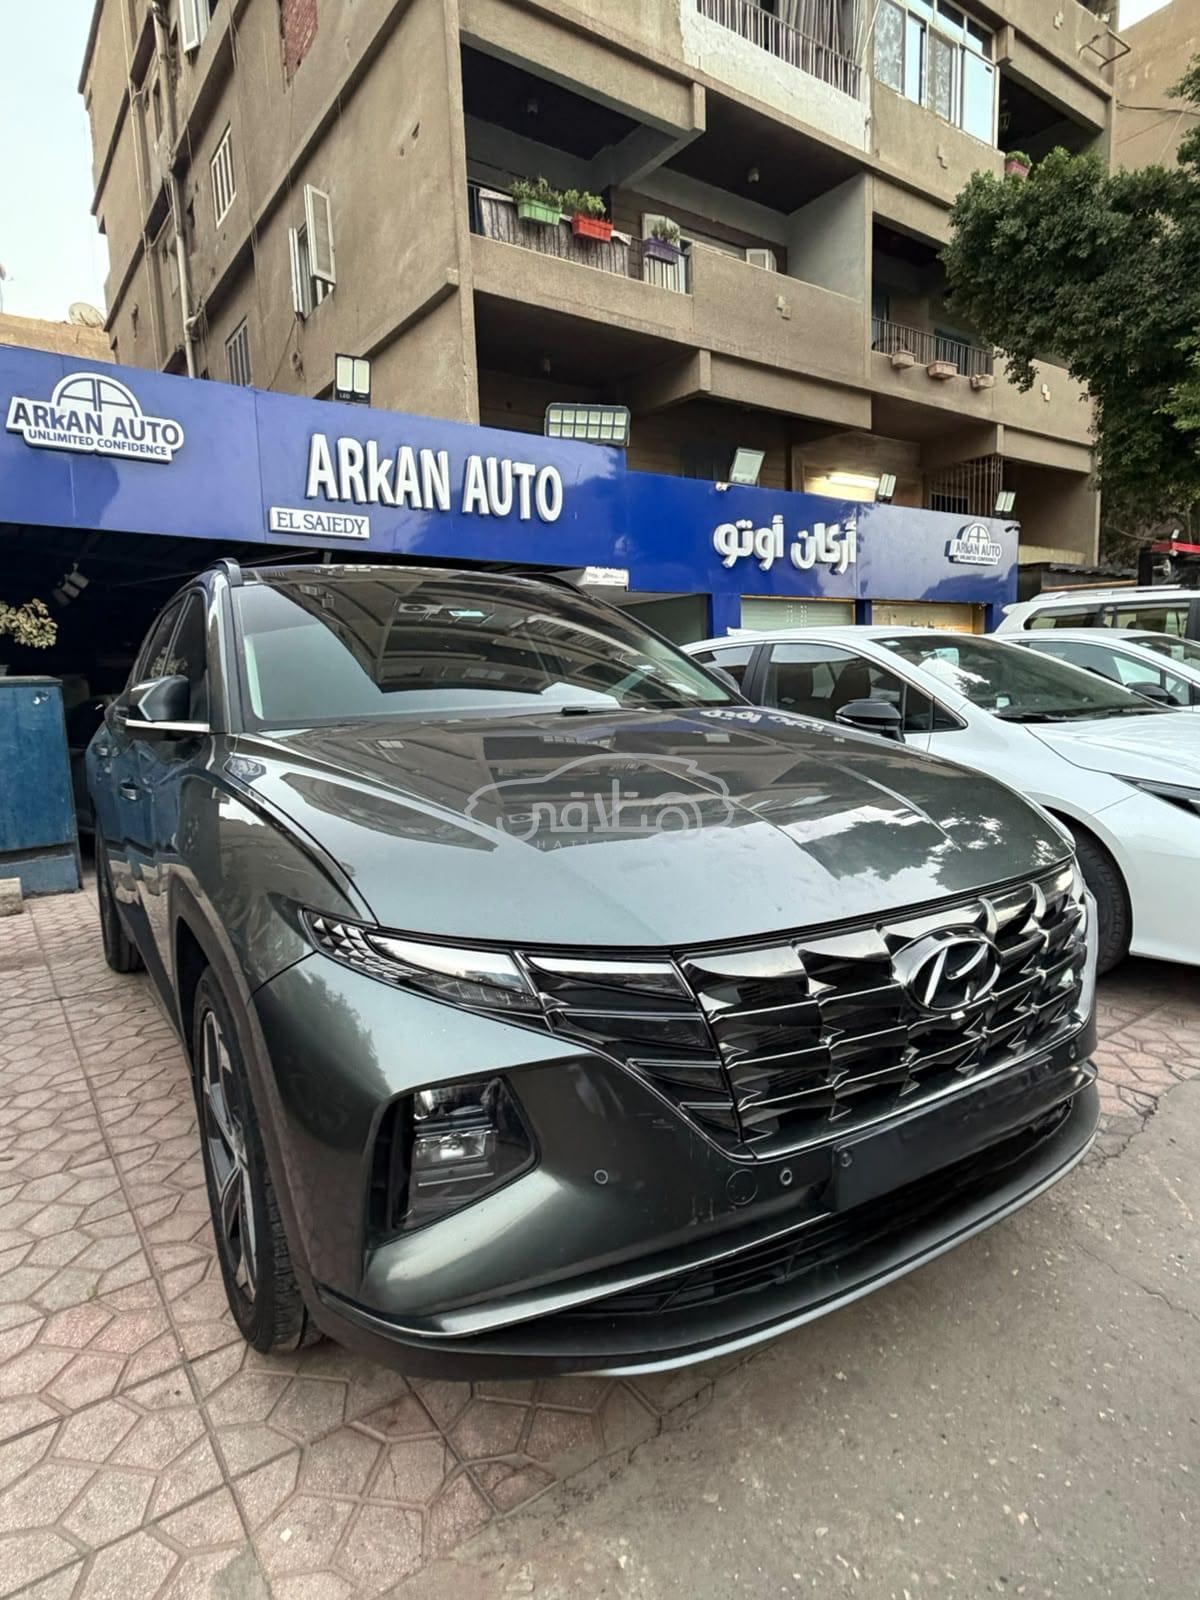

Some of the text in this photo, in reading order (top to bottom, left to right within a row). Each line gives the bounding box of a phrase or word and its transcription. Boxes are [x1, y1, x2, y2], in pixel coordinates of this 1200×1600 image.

[28, 428, 168, 456] UNLIMITED CONFIDENCE
[112, 416, 179, 446] AUTO
[462, 455, 563, 523] AUTO
[276, 511, 366, 535] EL SAIEDY
[713, 514, 857, 576] أركان أوتو
[981, 544, 1000, 557] AUTO
